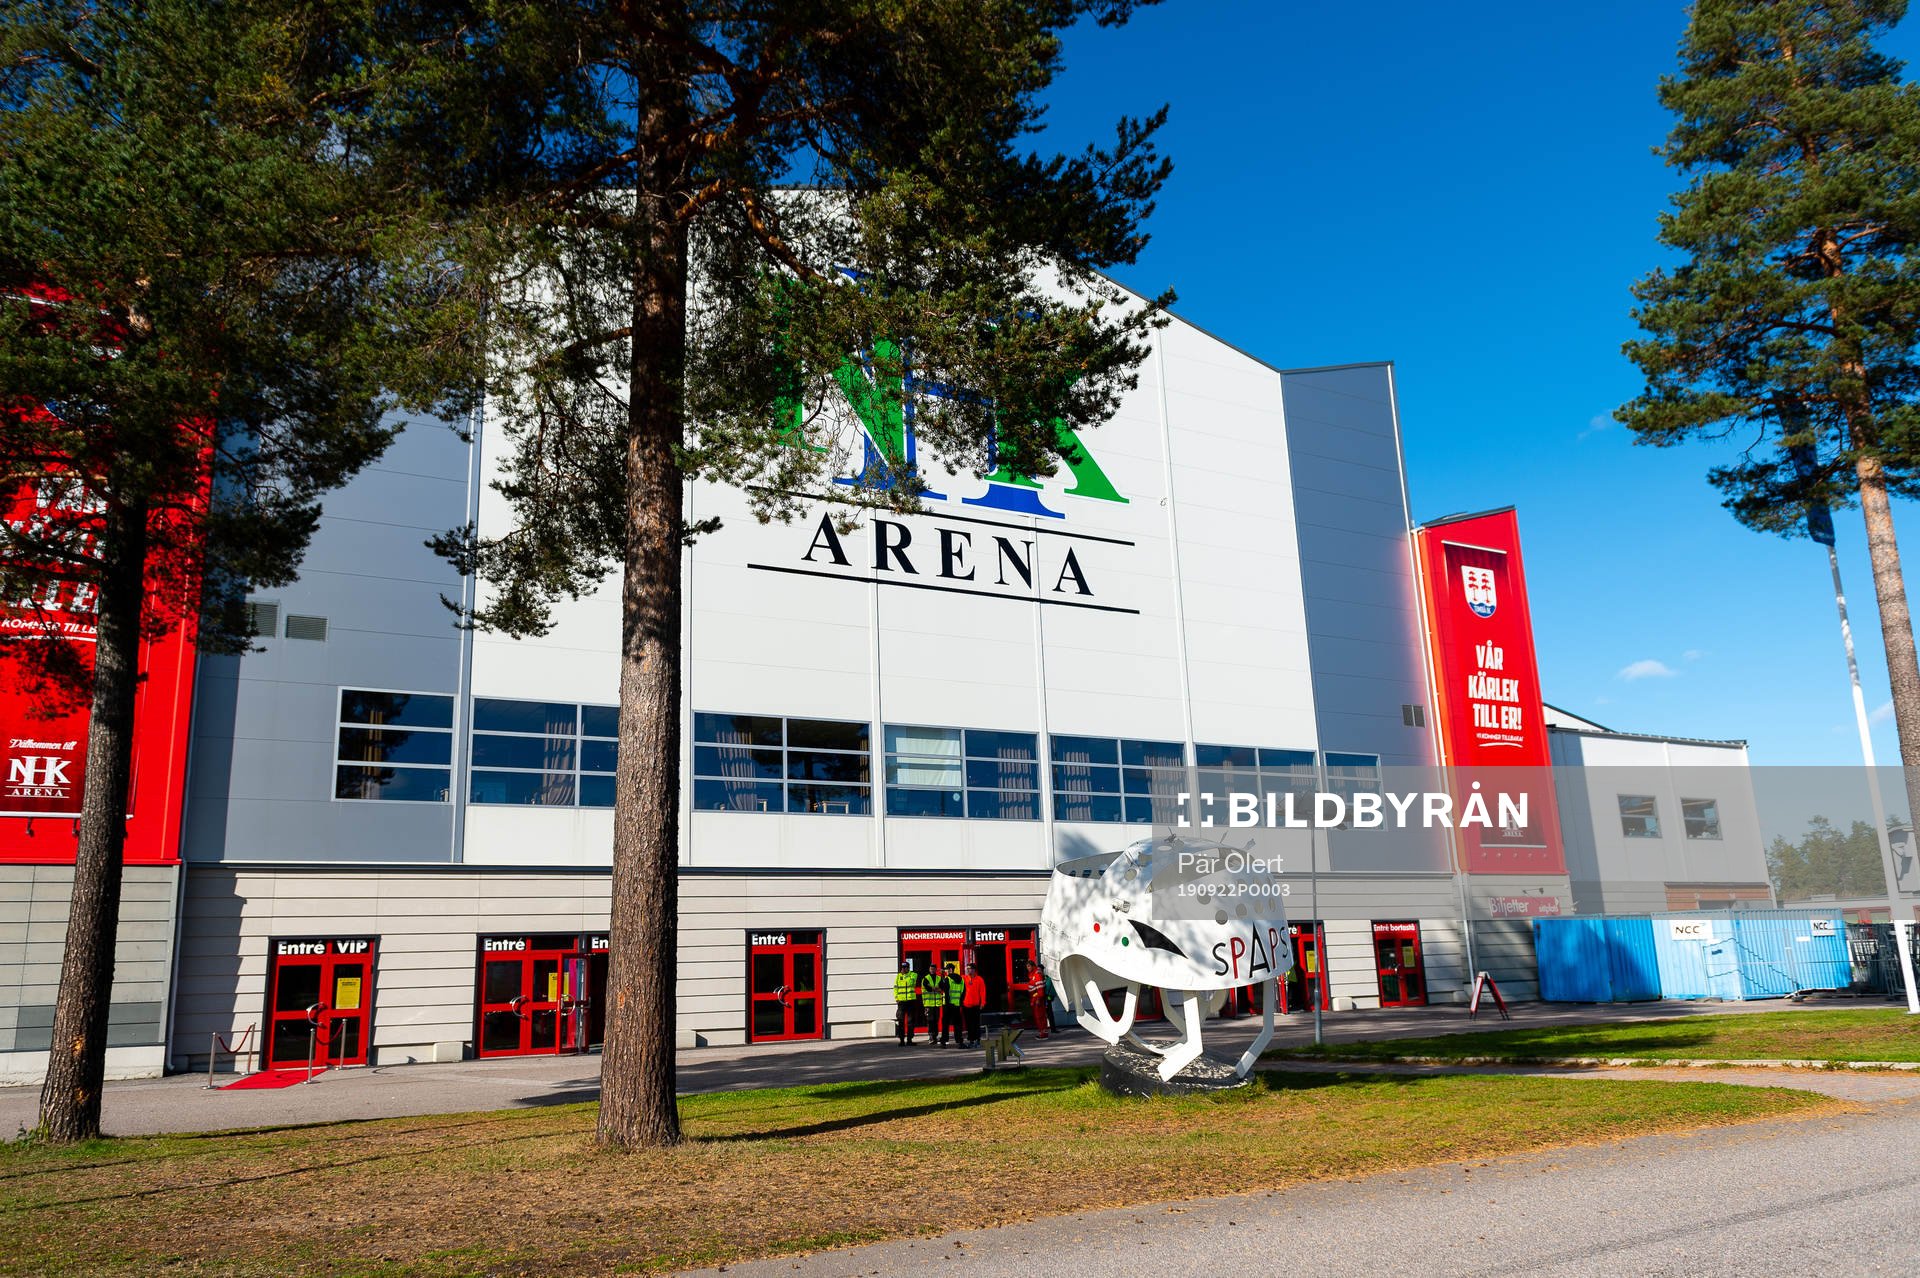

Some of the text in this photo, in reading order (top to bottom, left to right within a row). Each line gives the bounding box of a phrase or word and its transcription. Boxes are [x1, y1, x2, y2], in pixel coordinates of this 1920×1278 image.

[801, 511, 1095, 597] ARENA
[1475, 640, 1504, 670] VÅR
[1468, 671, 1520, 703] KÄRLEK
[1473, 703, 1522, 731] TILL ER!
[6, 755, 72, 787] NHK
[11, 788, 63, 797] ARENA
[1675, 925, 1700, 934] NCC
[1813, 922, 1828, 930] NCC
[278, 940, 368, 955] Entré VIP
[483, 937, 526, 951] Entré
[752, 932, 786, 946] Entré
[1212, 920, 1289, 980] SPAPS
